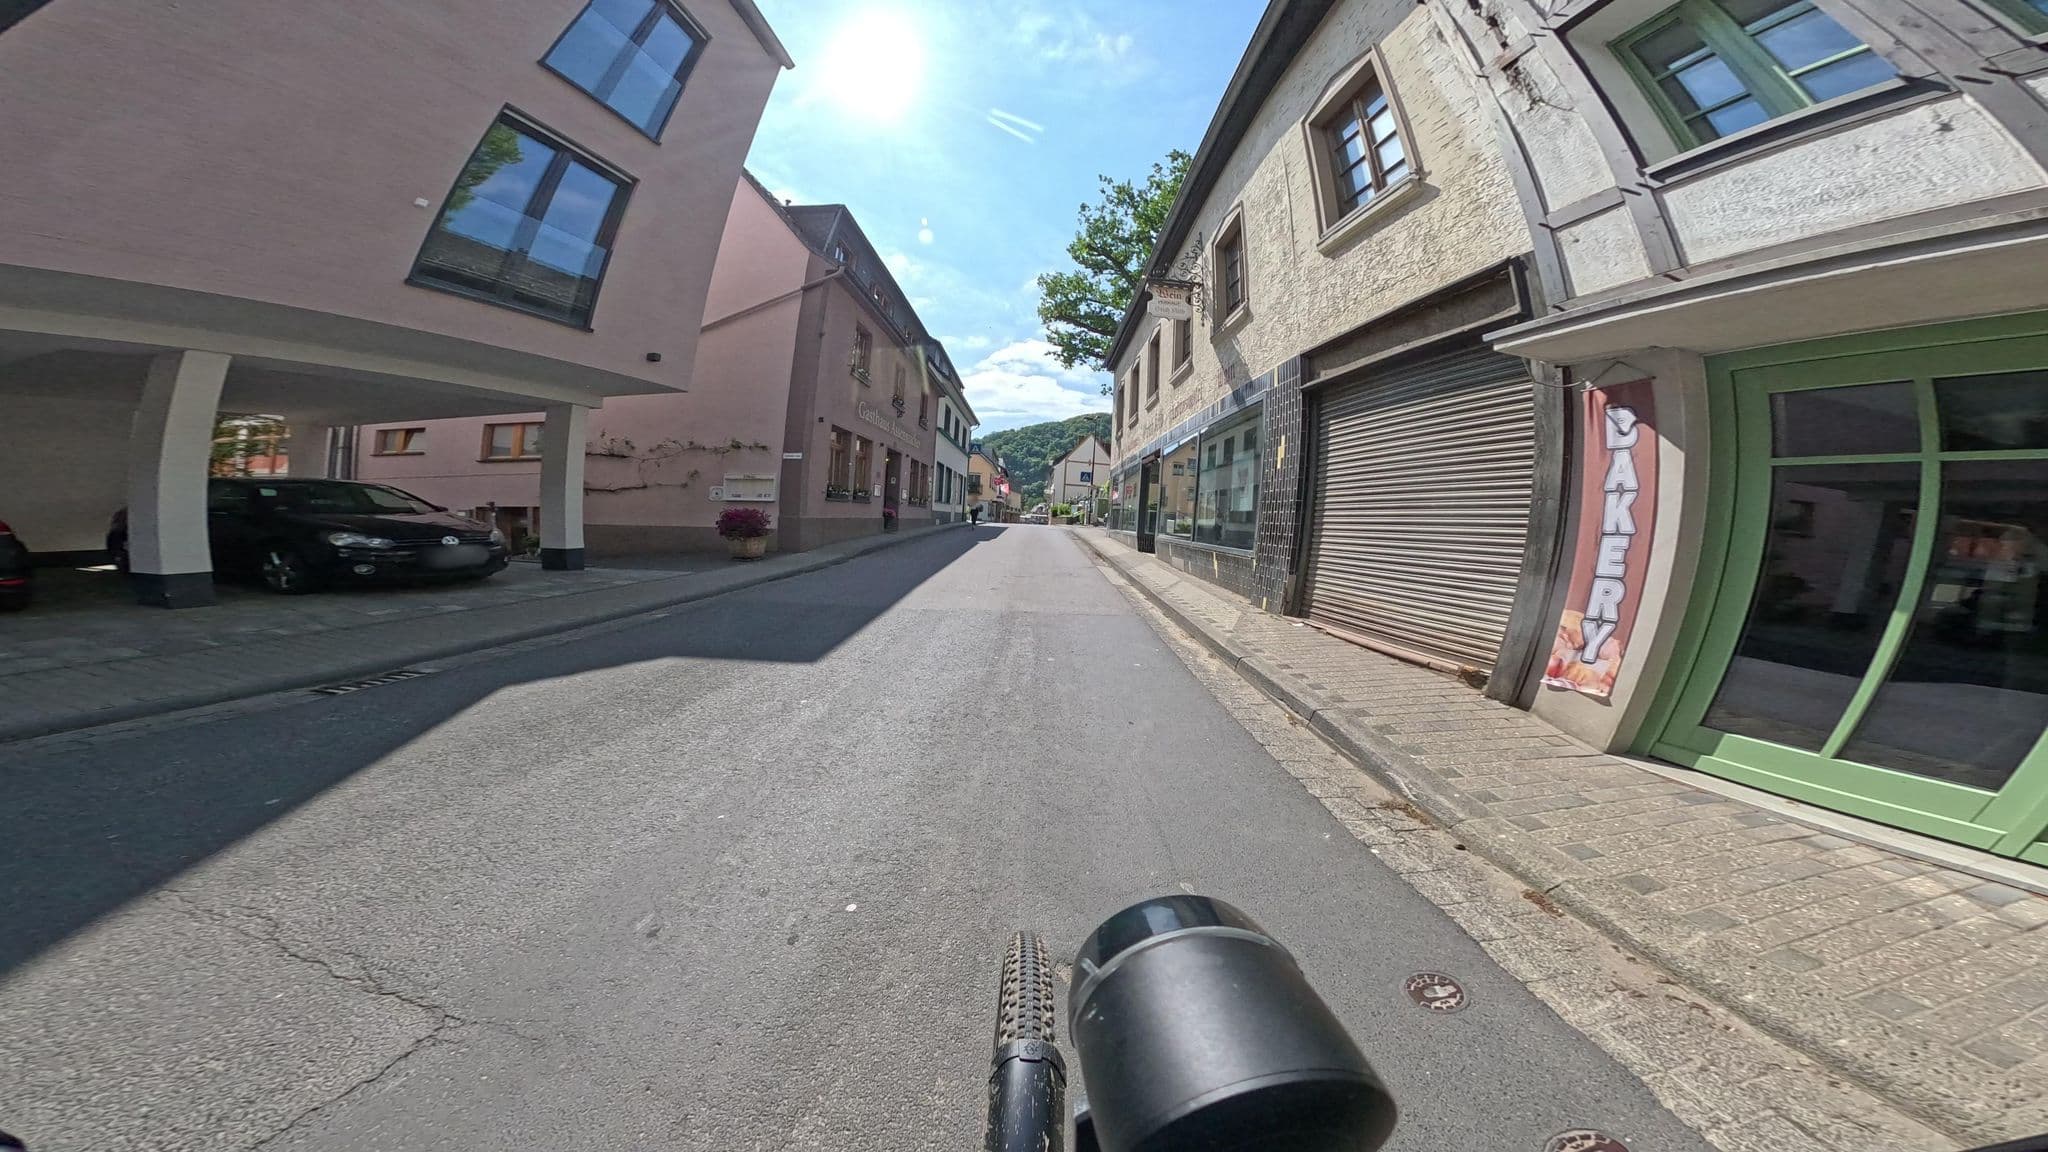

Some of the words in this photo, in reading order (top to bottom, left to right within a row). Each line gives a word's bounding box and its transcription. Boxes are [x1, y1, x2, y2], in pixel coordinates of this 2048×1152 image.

[1156, 287, 1182, 300] Wein
[858, 401, 890, 432] Gasthaus
[1581, 405, 1639, 664] BAKERY
